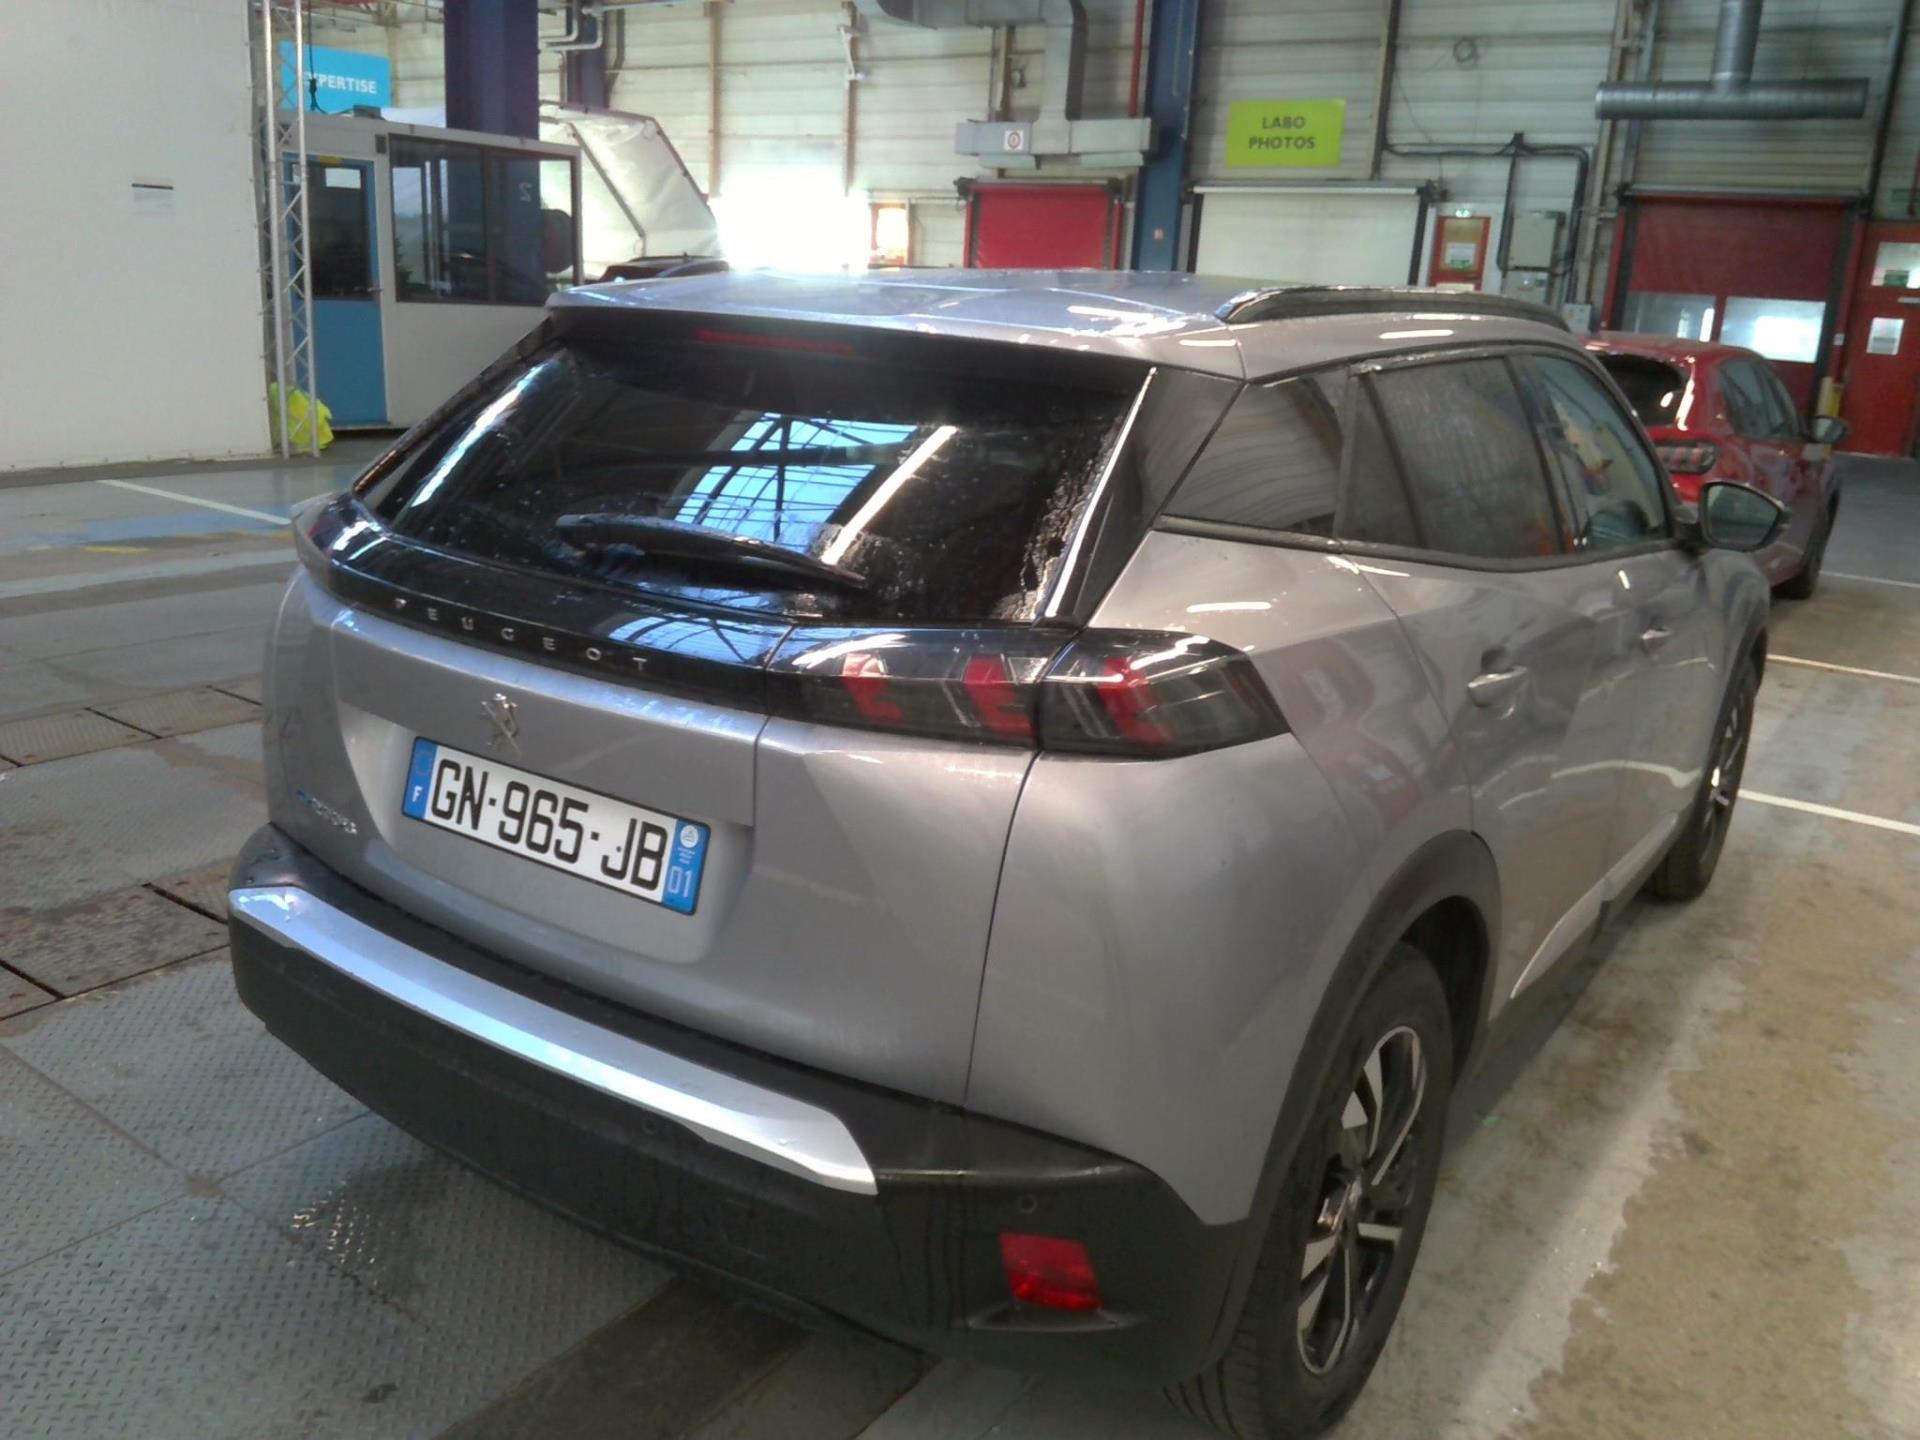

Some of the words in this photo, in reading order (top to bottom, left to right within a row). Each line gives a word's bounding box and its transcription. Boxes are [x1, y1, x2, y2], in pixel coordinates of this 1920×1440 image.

[1262, 115, 1306, 130] LABO
[1248, 135, 1316, 150] PHOTOS
[395, 597, 648, 672] PEUGEOT
[411, 785, 424, 803] F
[667, 865, 694, 898] 01
